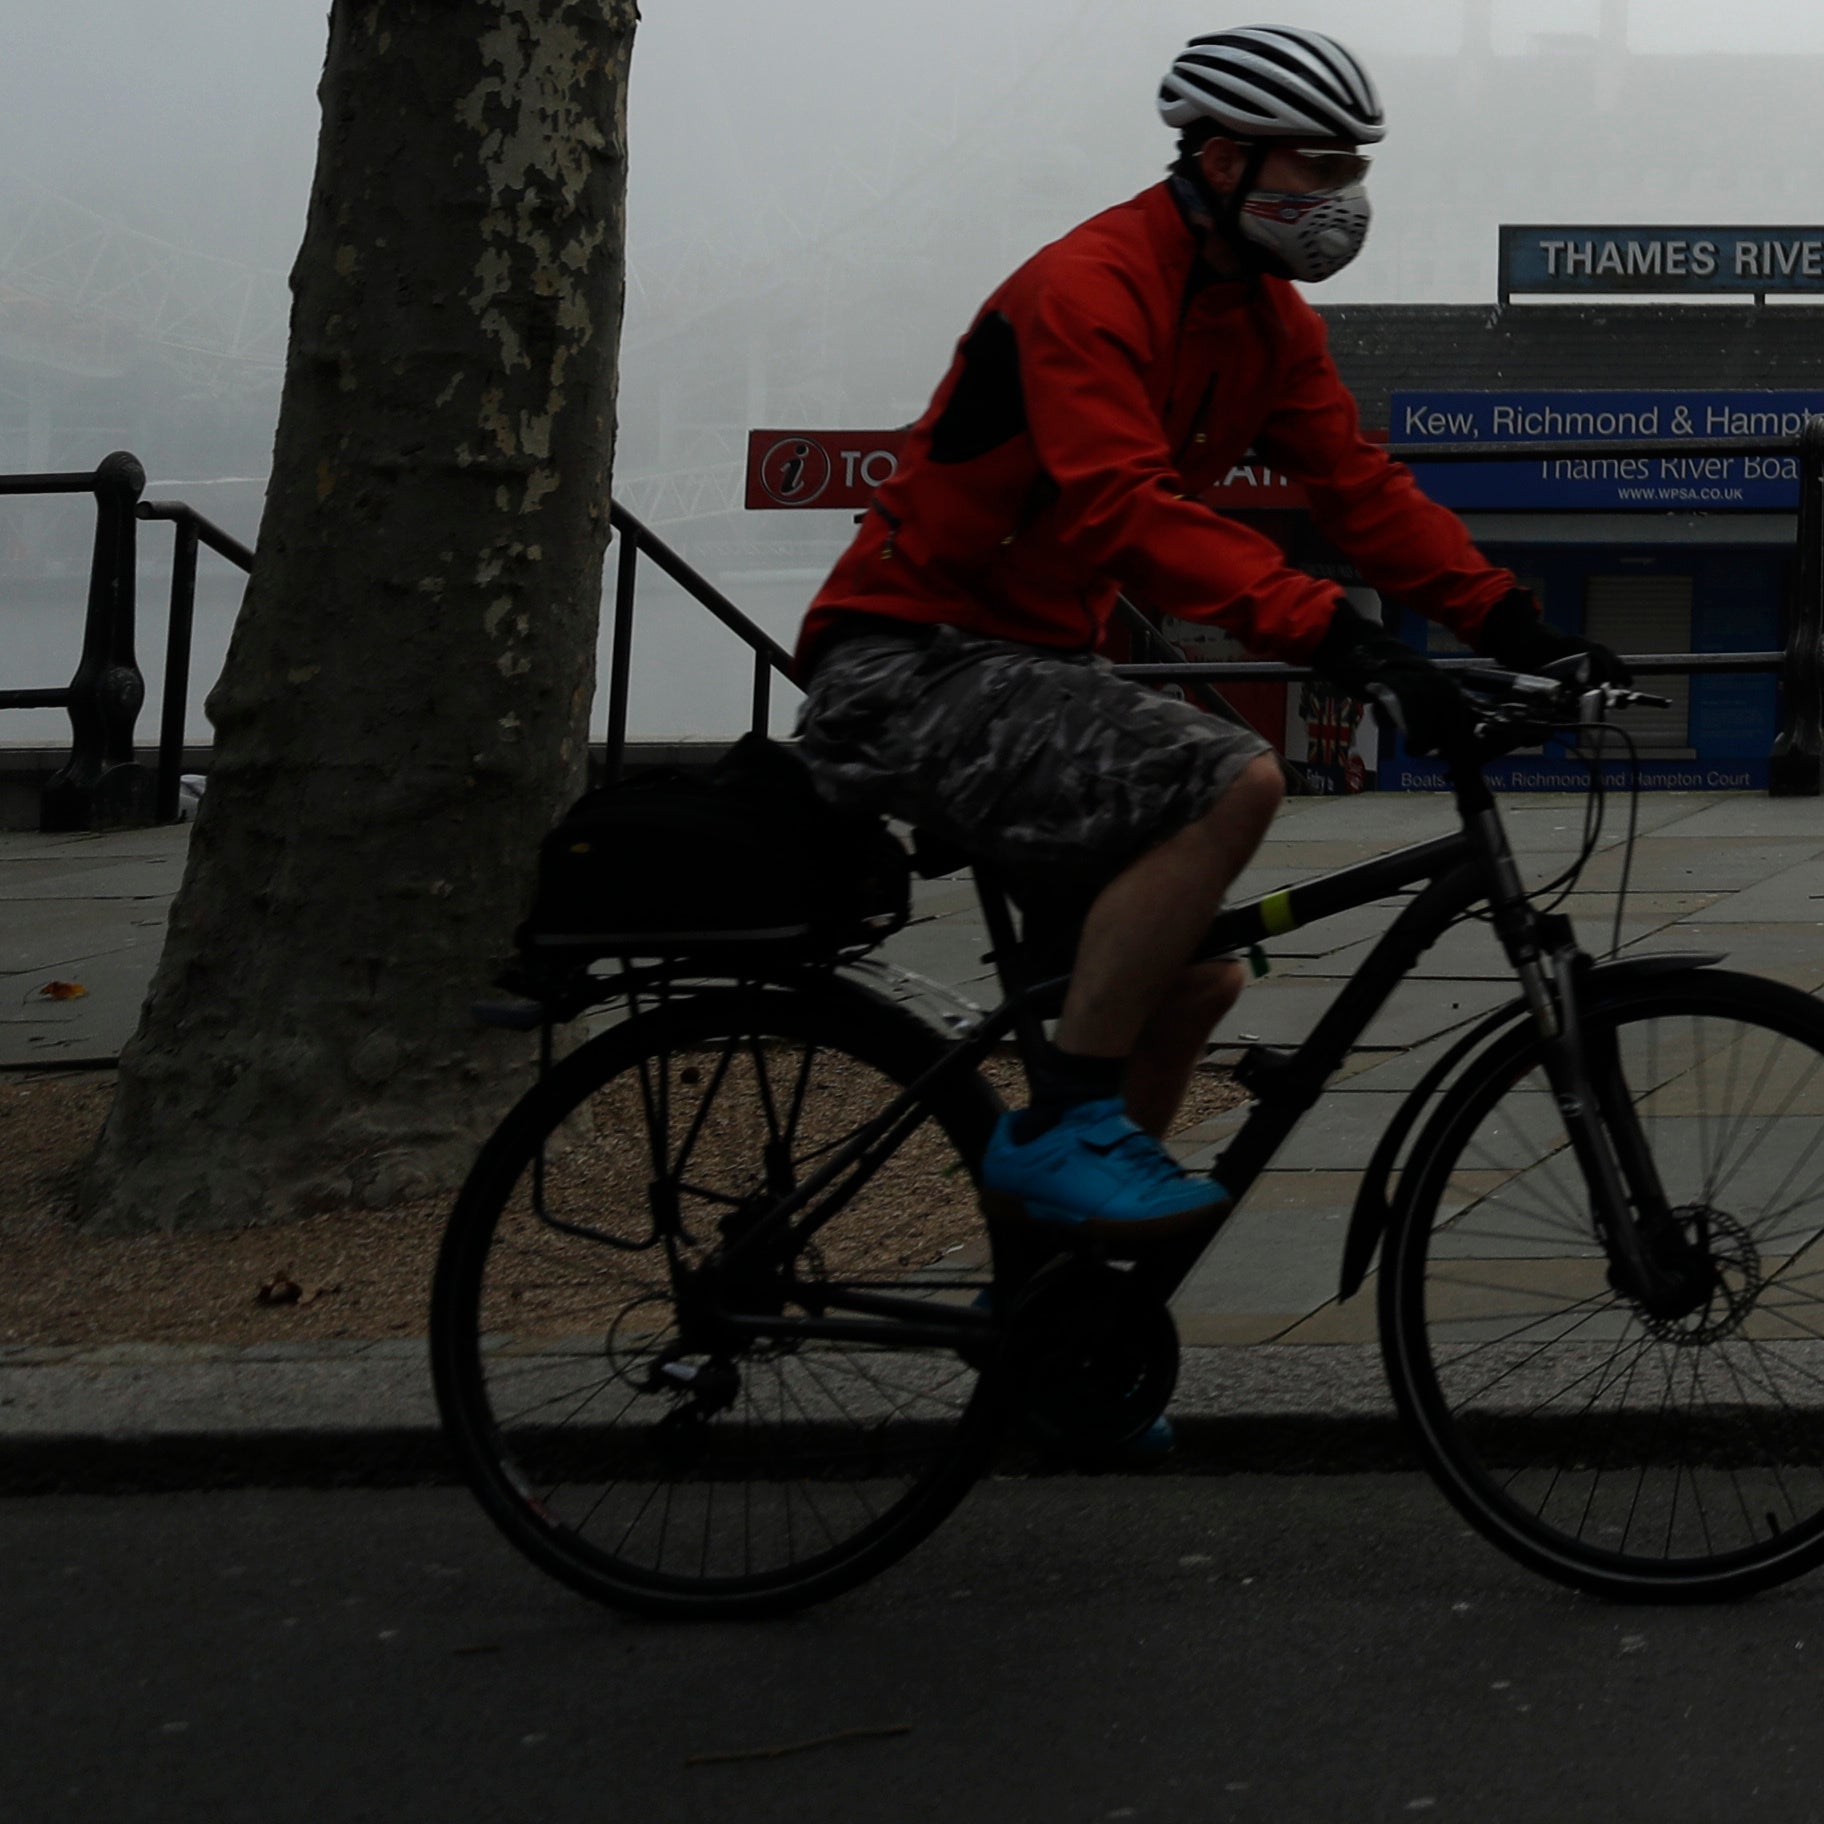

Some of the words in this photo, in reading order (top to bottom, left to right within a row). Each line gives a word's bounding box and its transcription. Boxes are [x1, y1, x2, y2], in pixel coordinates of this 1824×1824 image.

[1539, 240, 1719, 277] THAMES
[1404, 405, 1480, 439] Kew,
[1493, 405, 1660, 436] Richmond
[1671, 404, 1695, 436] &
[840, 450, 898, 488] TO
[1744, 457, 1798, 480] Boa
[1617, 487, 1744, 502] WWW.WPSA.CO.UK
[1401, 772, 1447, 789] Boats
[1482, 775, 1506, 788] ew,
[1511, 771, 1592, 788] Richmond
[1707, 772, 1751, 787] Court
